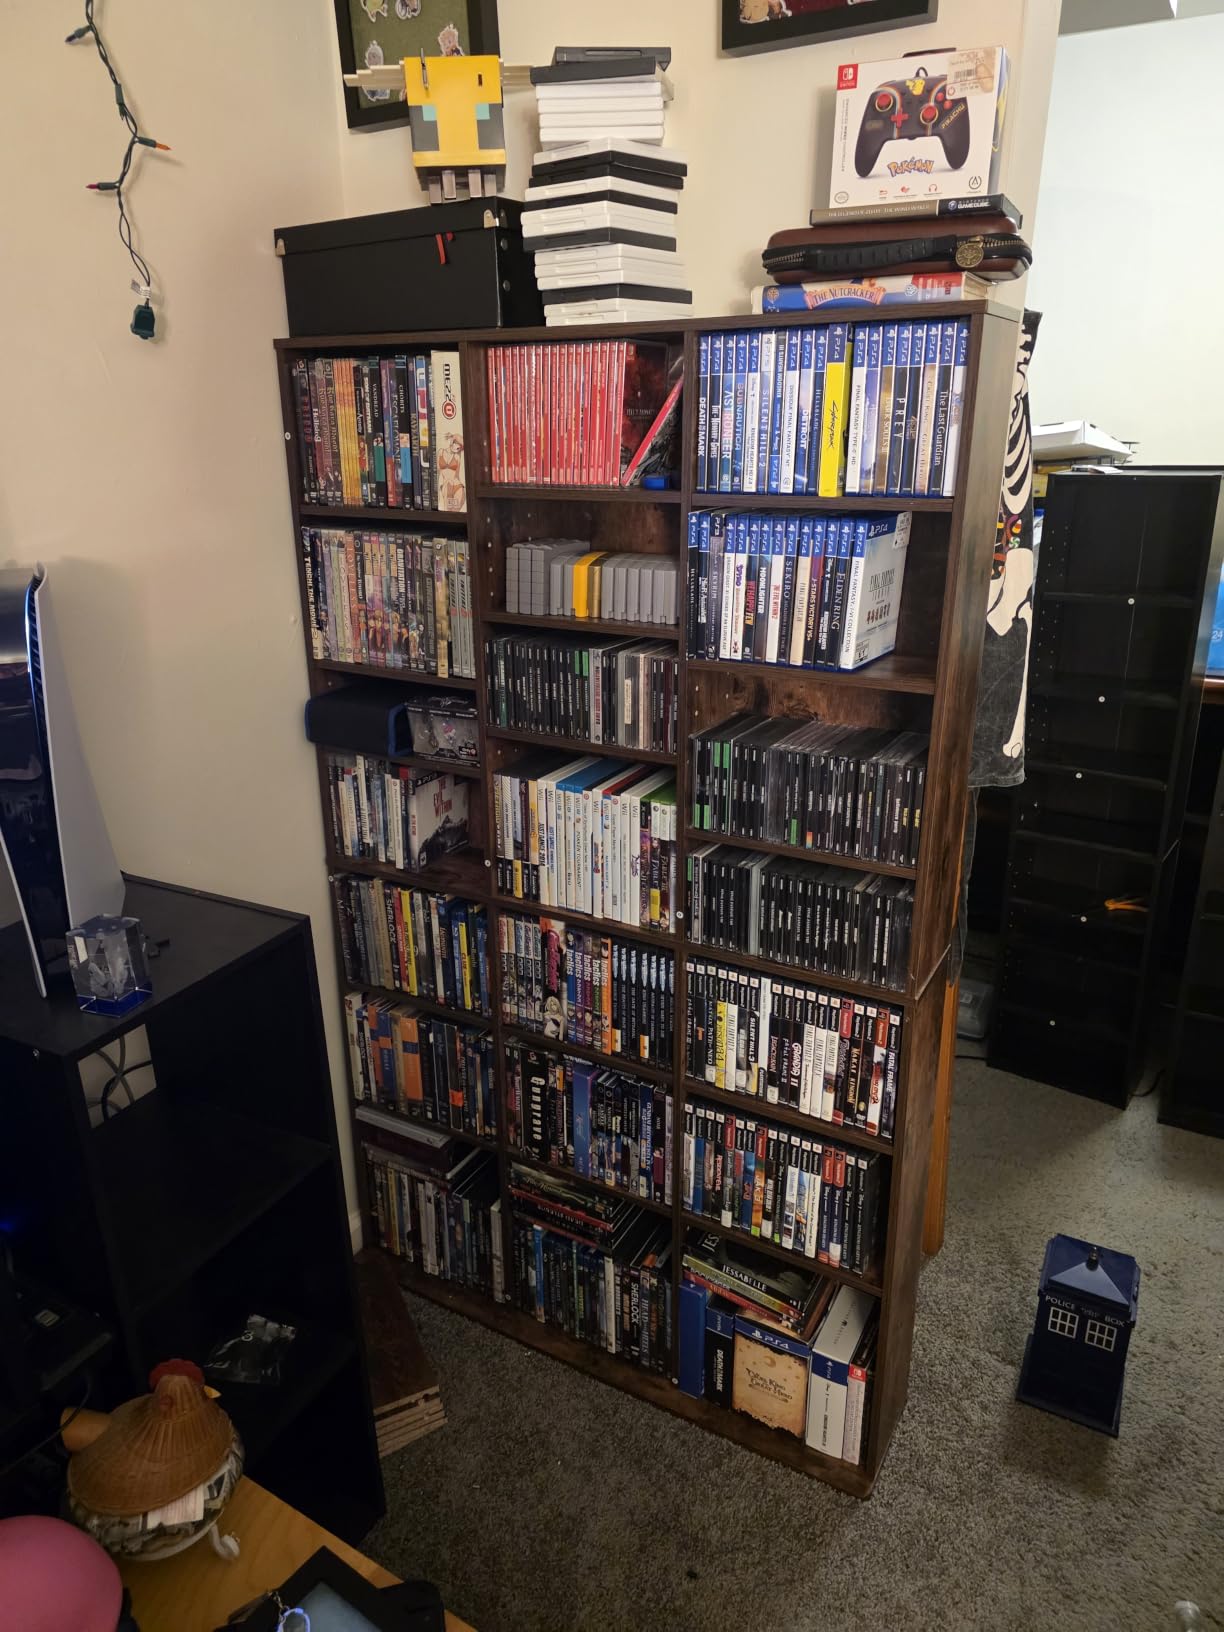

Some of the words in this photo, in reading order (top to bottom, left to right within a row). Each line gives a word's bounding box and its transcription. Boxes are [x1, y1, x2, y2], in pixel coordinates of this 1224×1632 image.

[941, 104, 966, 130] PIKACHU
[813, 290, 827, 304] THE
[829, 288, 874, 300] NUTCRACKER
[760, 390, 769, 430] SILENT
[939, 390, 948, 406] The
[722, 390, 733, 459] ASTRONEER
[735, 383, 744, 450] SUBNAUTICA
[800, 409, 809, 449] DETROIT
[894, 397, 905, 438] PREY
[937, 407, 947, 426] Last
[697, 432, 705, 456] MARK
[759, 433, 768, 457] HILL
[883, 421, 891, 445] SOULS
[934, 427, 943, 466] Guardian
[397, 549, 405, 592] GRAVITATION
[305, 557, 313, 586] TENCHI
[309, 604, 317, 628] MOVIE
[746, 590, 755, 612] HAPPY
[757, 567, 767, 614] MOONLIGHTER
[835, 572, 845, 604] ELDEN
[745, 613, 754, 625] FEW
[831, 606, 841, 629] RING
[844, 619, 853, 652] COLLECTION
[652, 860, 660, 885] FABLE
[660, 855, 668, 880] FABLE
[385, 899, 396, 944] SHERLOCK
[566, 949, 574, 975] tactics
[592, 959, 600, 986] tactics
[781, 1059, 789, 1076] FRAME
[791, 1043, 802, 1076] GRANDIA
[851, 1047, 860, 1073] MAKAI
[790, 1078, 799, 1087] II
[530, 1077, 545, 1140] Gungrave
[722, 1264, 767, 1292] JESSABELLE
[631, 1282, 639, 1324] SHERLOCK
[1045, 1295, 1075, 1310] POLICE
[1104, 1315, 1125, 1327] BOX
[765, 1336, 789, 1349] PS4
